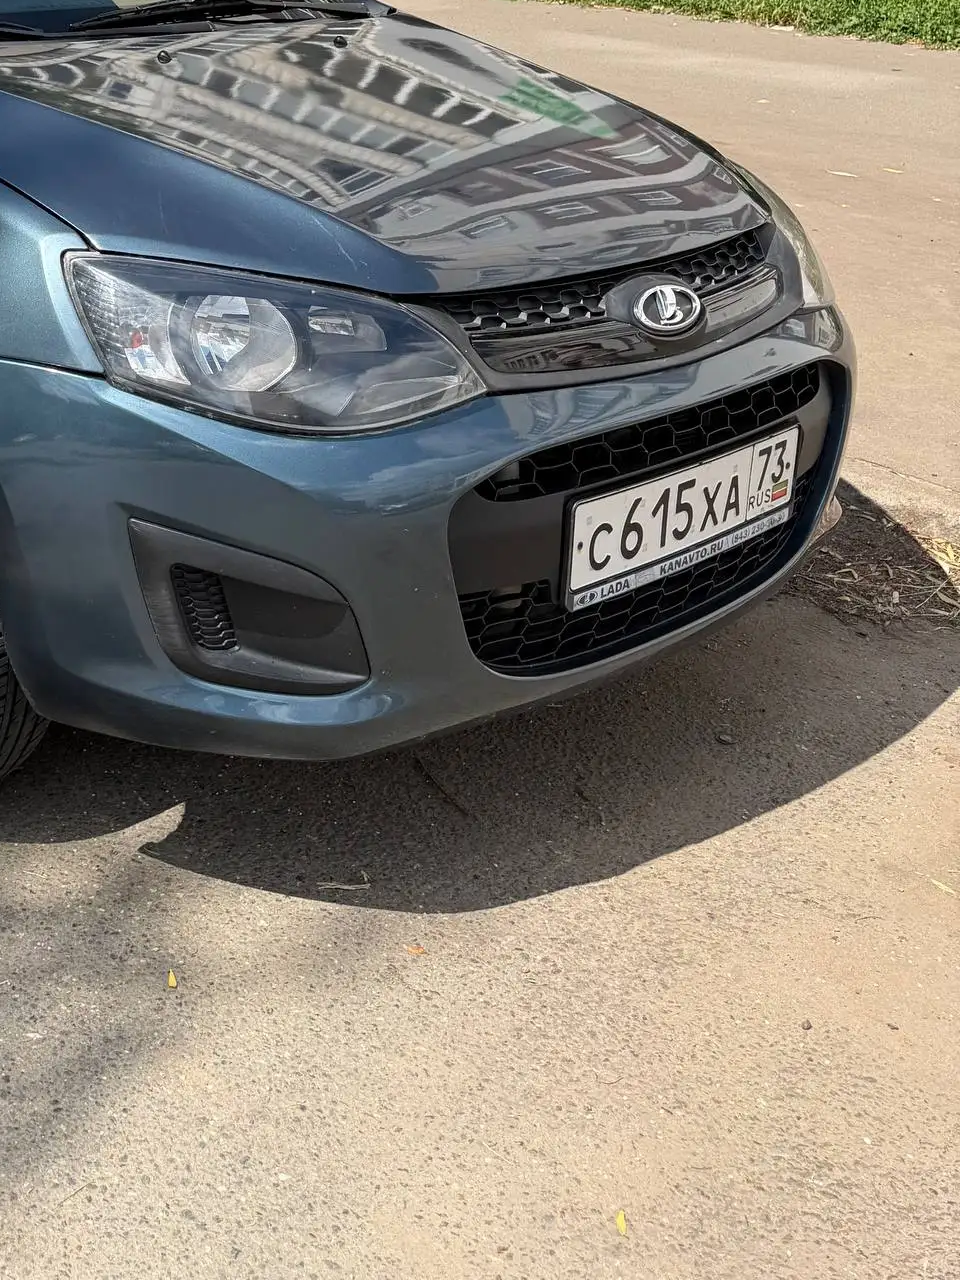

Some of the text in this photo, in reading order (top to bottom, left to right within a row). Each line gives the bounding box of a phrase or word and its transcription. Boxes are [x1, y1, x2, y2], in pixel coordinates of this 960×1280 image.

[757, 439, 788, 492] 73
[748, 490, 771, 511] RUS
[600, 578, 630, 598] LADA
[659, 543, 724, 576] KANAVTO.RU
